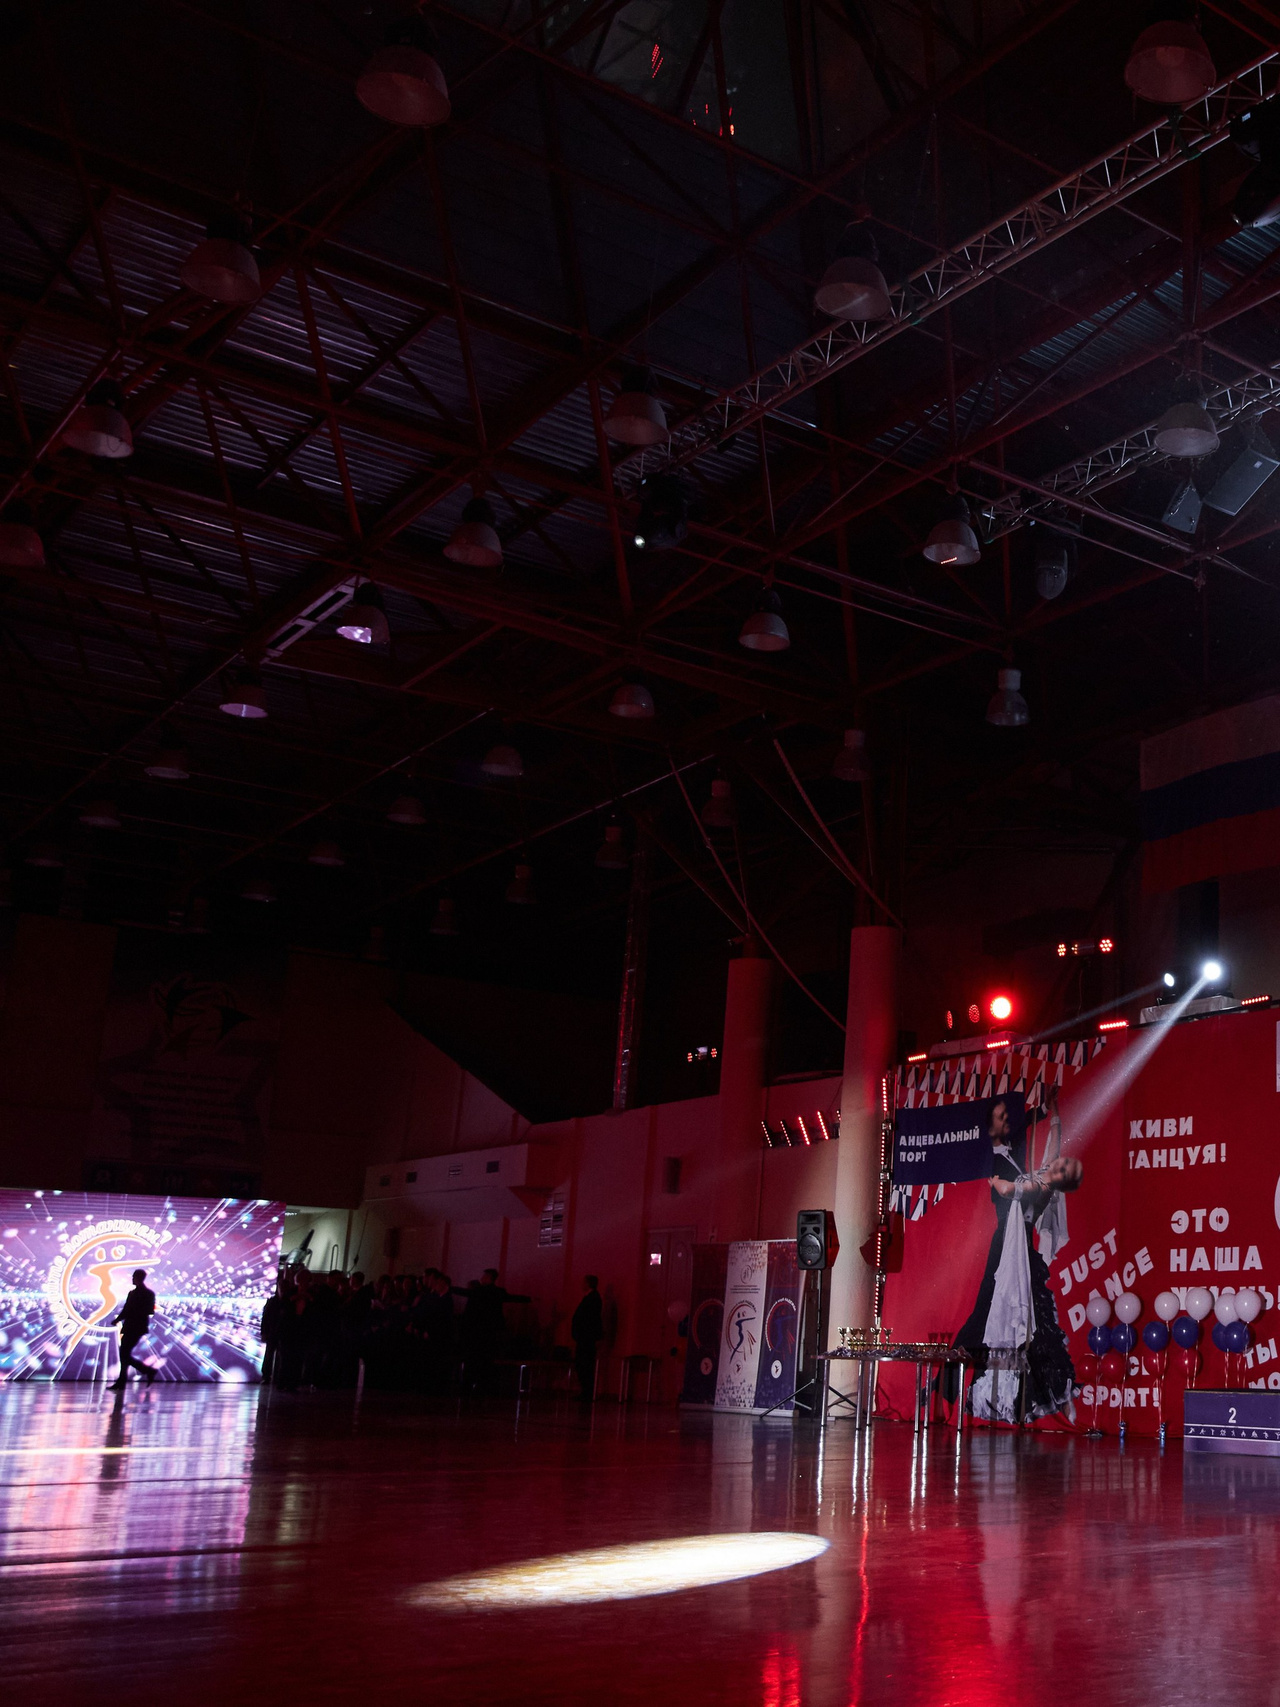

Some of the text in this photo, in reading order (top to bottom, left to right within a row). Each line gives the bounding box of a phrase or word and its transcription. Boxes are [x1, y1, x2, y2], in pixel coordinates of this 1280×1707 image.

[1129, 1116, 1193, 1140] ЖИВИ
[1171, 1207, 1230, 1234] ЭТО
[1059, 1228, 1117, 1296] JUST
[1170, 1245, 1263, 1272] НАША
[1244, 1338, 1278, 1369] ТЫ
[1082, 1384, 1160, 1408] SPORT!
[1228, 1407, 1237, 1424] 2
